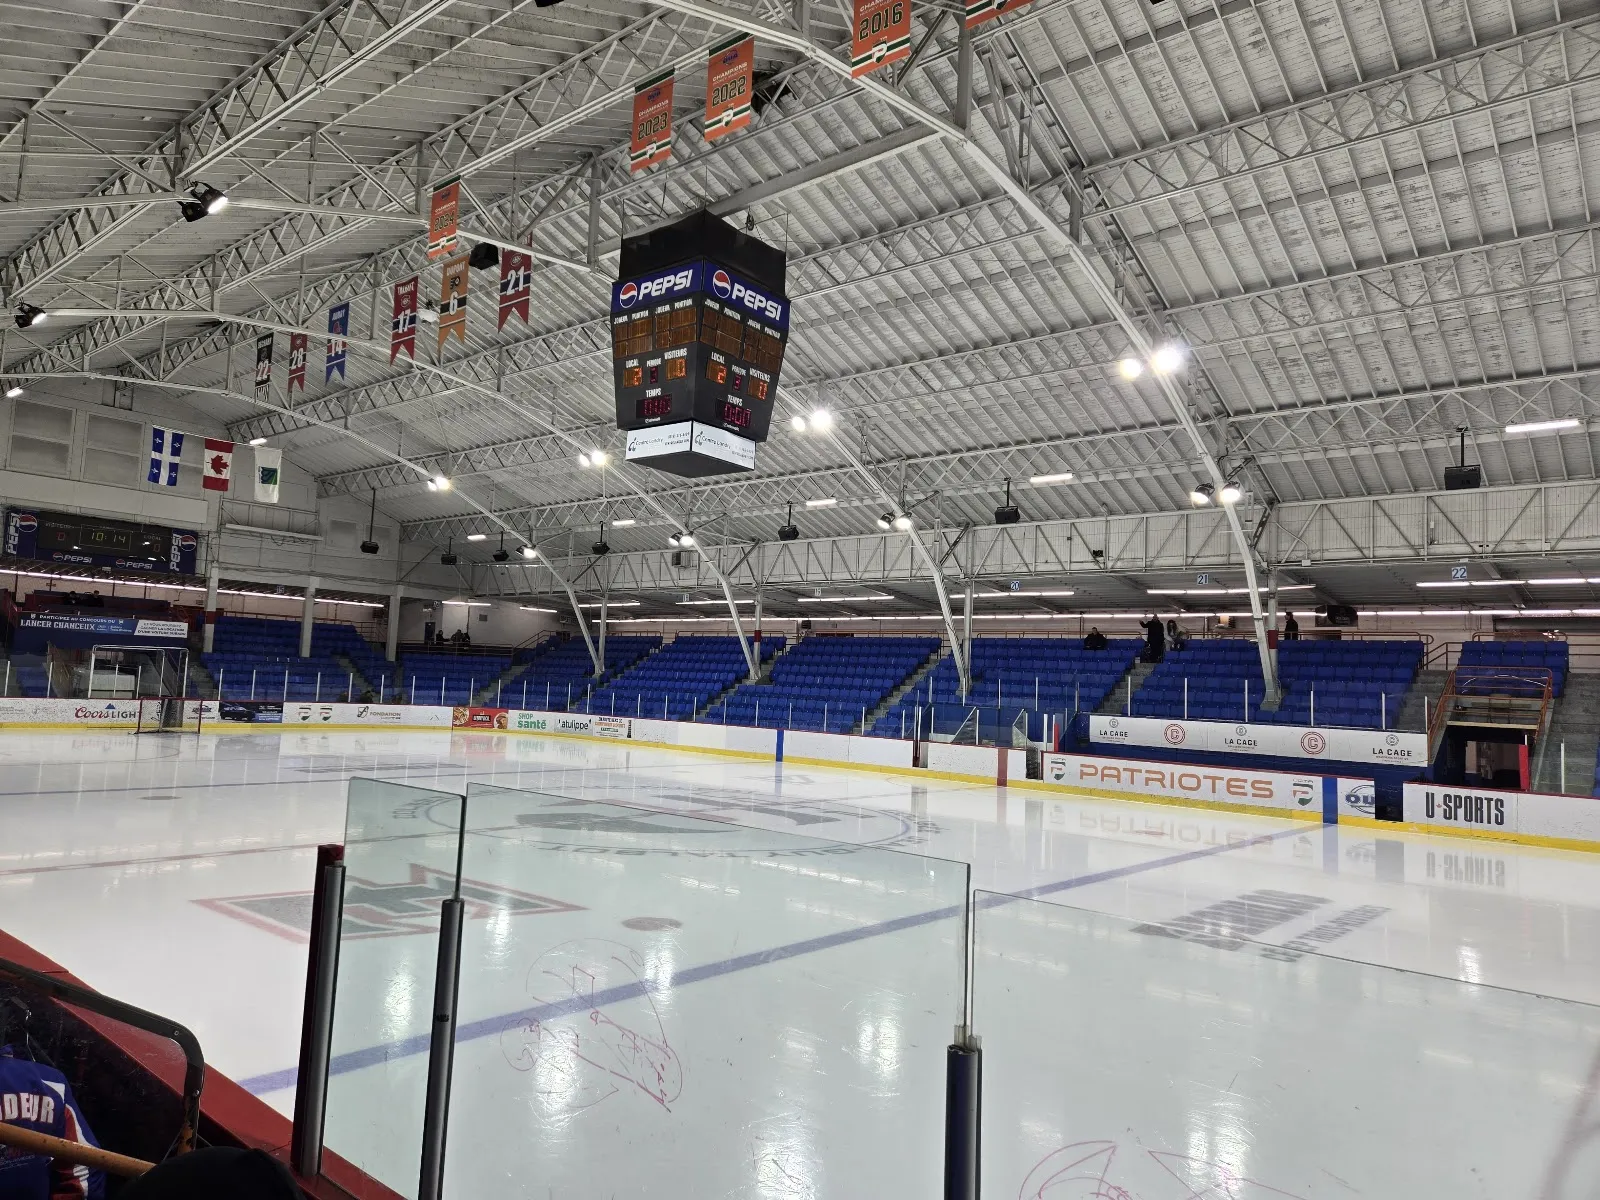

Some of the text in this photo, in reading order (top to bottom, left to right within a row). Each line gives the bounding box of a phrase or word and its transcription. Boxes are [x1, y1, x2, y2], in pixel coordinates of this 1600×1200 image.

[859, 1, 903, 41] 2016
[712, 61, 748, 82] CHAMPIONS
[712, 75, 747, 108] 2022
[638, 99, 669, 117] CHAMPIONS
[637, 111, 668, 141] 2023
[433, 210, 455, 233] 2024
[446, 261, 466, 277] DUPONT
[506, 265, 525, 296] 21
[638, 268, 693, 301] PEPSI
[449, 291, 459, 316] 6
[731, 282, 782, 321] PEPSI
[397, 308, 411, 334] 17
[331, 338, 343, 357] 14
[291, 347, 304, 370] 28
[625, 358, 640, 369] LOCAL
[663, 347, 688, 360] VISITEURS
[711, 351, 725, 365] LOCAL
[256, 358, 269, 381] 22
[717, 364, 727, 384] 2
[645, 387, 662, 398] TEMPS
[758, 380, 769, 400] 0
[727, 394, 743, 407] TEMPS
[5, 512, 20, 555] PEPSI
[63, 554, 93, 564] PEPSI
[169, 533, 182, 572] PEPSI
[125, 561, 153, 570] PEPSI
[1452, 567, 1467, 578] 22
[1198, 575, 1208, 584] 21
[20, 619, 52, 628] LANCER
[53, 621, 95, 631] CHANCEUX
[75, 706, 110, 719] Coors
[517, 719, 547, 730] santé
[1109, 730, 1129, 738] CAGE
[1224, 737, 1258, 747] LA CAGE
[1372, 747, 1412, 757] LA CAGE
[1080, 763, 1274, 799] PATRIOTES
[1442, 793, 1505, 825] SPORTS
[0, 1092, 55, 1124] DEUR
